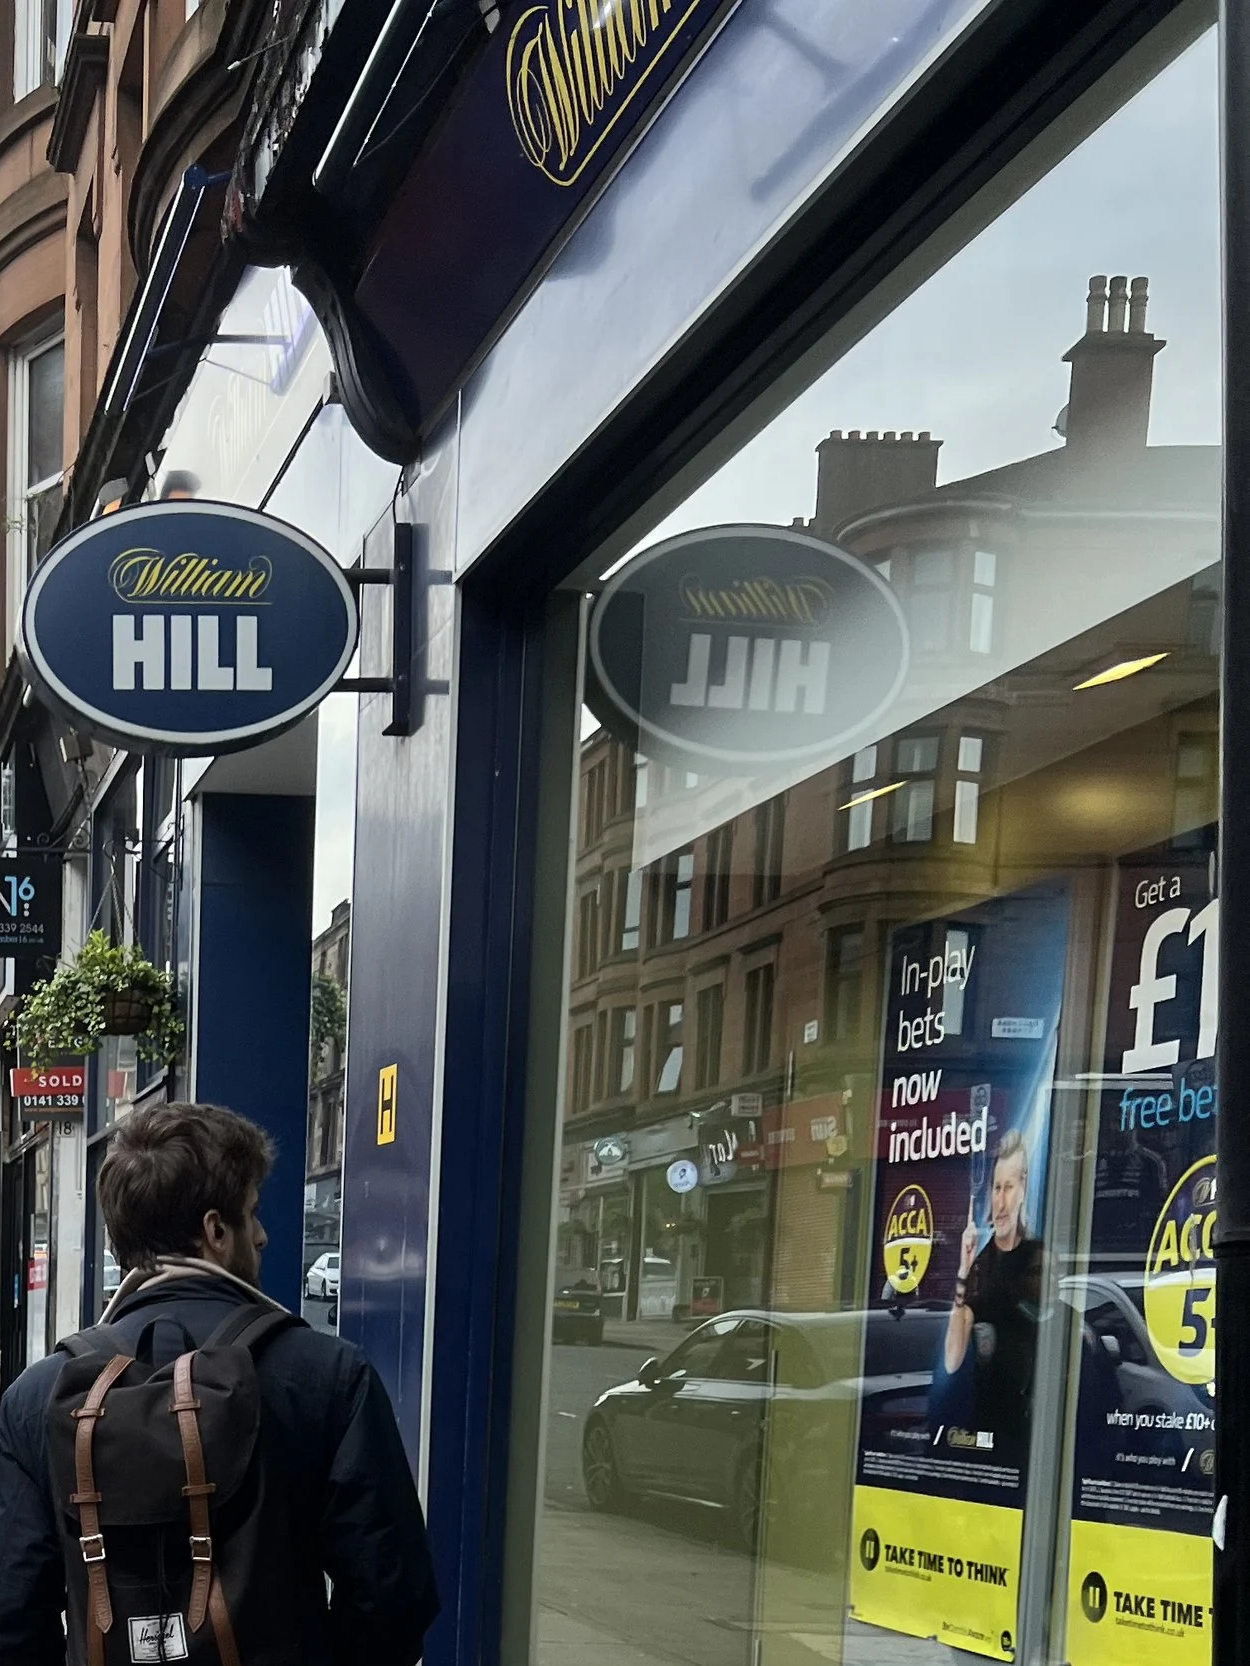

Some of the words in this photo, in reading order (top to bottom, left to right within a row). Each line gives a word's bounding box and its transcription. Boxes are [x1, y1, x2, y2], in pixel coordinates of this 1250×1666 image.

[108, 548, 273, 605] William
[113, 615, 272, 691] HILL
[1135, 878, 1167, 909] Get
[1169, 875, 1181, 898] a
[19, 923, 44, 934] 2544
[901, 941, 975, 999] In-play
[897, 1006, 946, 1052] bets
[23, 1095, 52, 1106] 0141
[56, 1095, 79, 1106] 339
[38, 1075, 83, 1088] SOLD
[892, 1069, 943, 1109] now
[58, 1121, 72, 1136] 18
[1118, 1086, 1173, 1133] free
[888, 1105, 989, 1164] included
[888, 1208, 928, 1241] ACCA
[1106, 1409, 1134, 1426] when
[1134, 1413, 1155, 1430] you
[1155, 1411, 1184, 1430] stake
[1185, 1412, 1211, 1431] £10+
[884, 1544, 915, 1566] TAKE
[918, 1550, 944, 1573] TIME
[947, 1556, 963, 1577] TO
[966, 1561, 1008, 1587] THINK
[1113, 1591, 1155, 1619] TAKE
[1160, 1599, 1203, 1628] TIME
